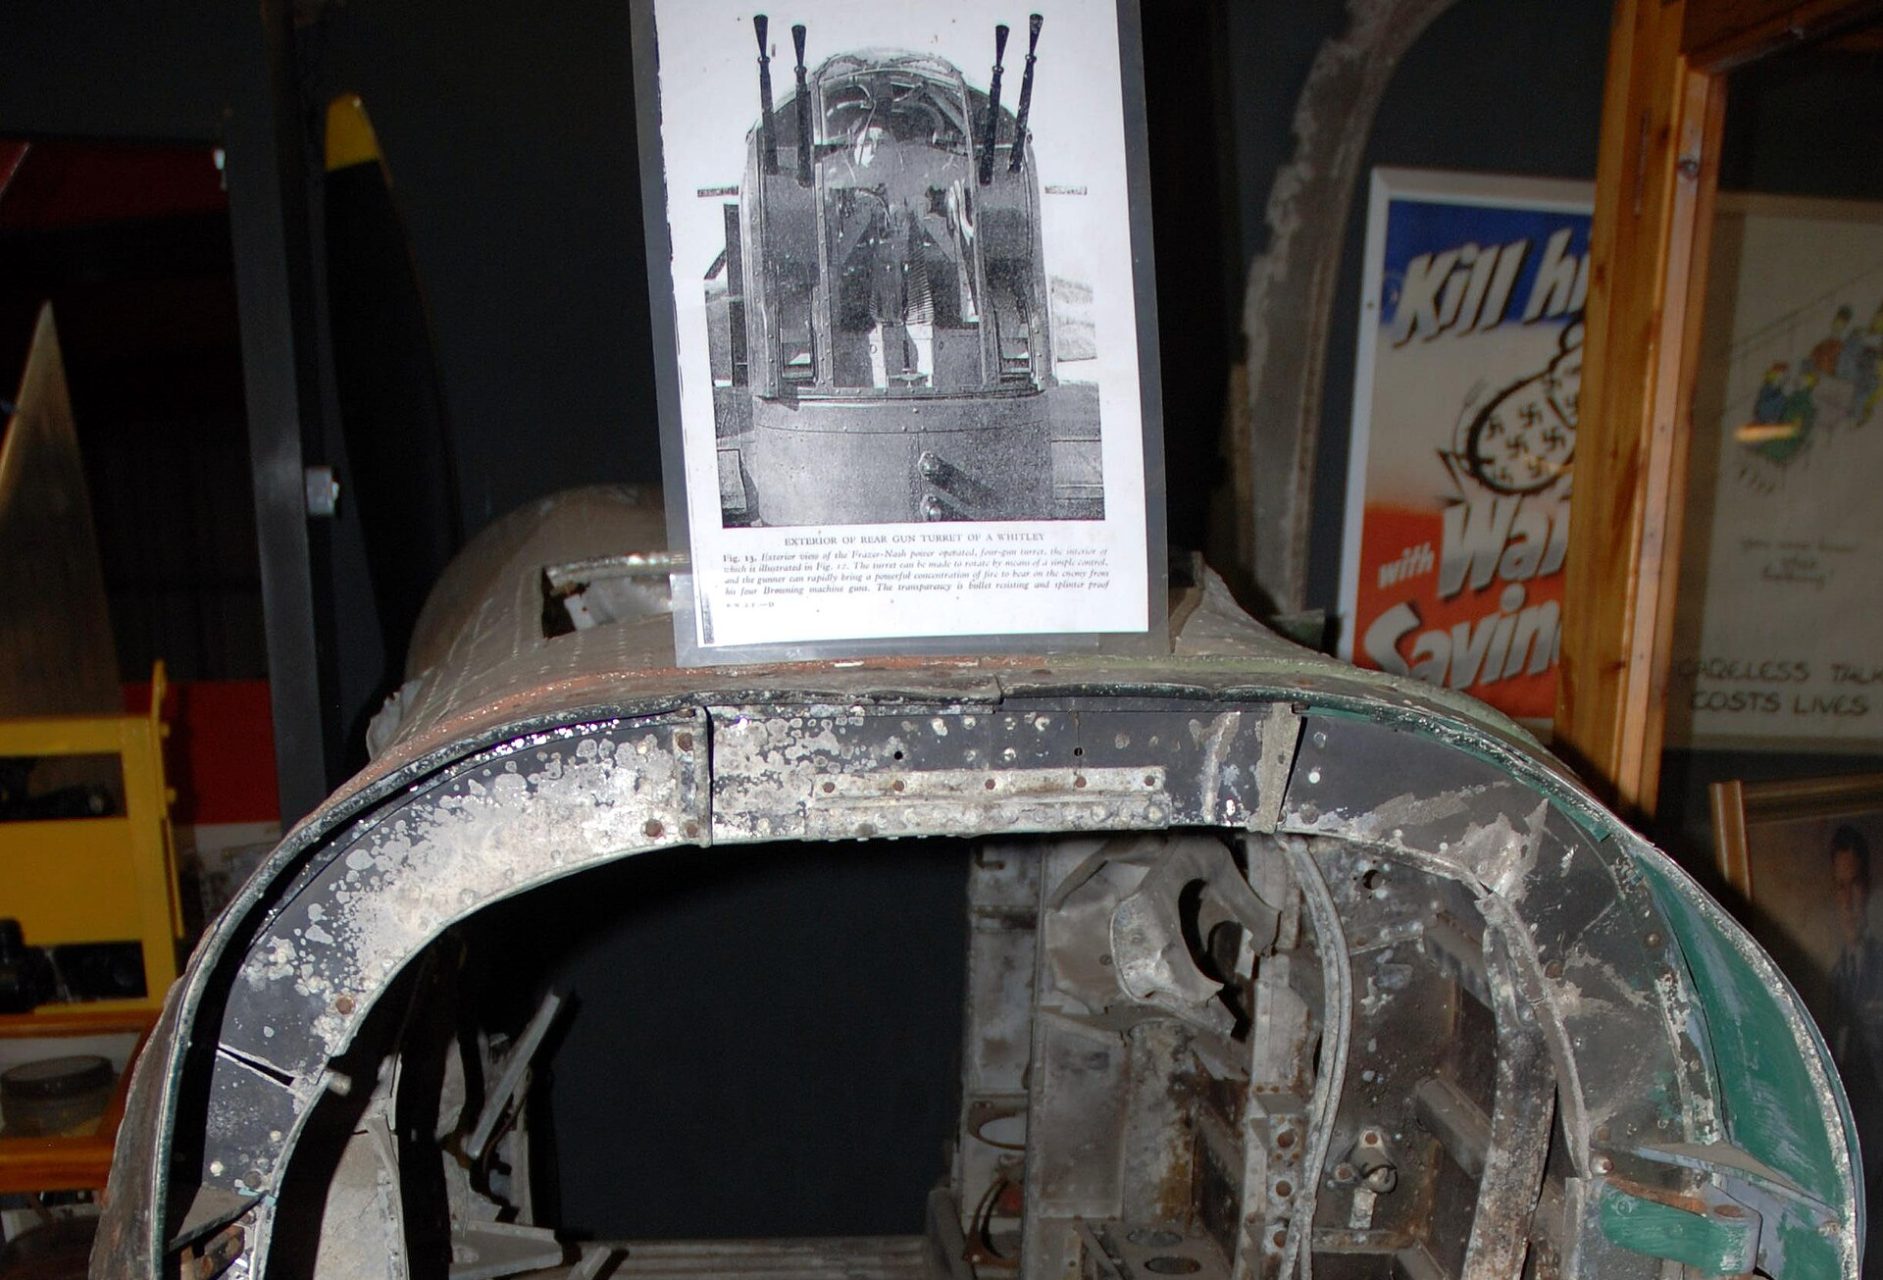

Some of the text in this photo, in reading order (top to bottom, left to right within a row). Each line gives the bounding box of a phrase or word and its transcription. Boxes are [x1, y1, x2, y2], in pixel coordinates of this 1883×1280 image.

[1392, 240, 1532, 348] Kill
[784, 533, 1045, 546] EXTERIOR OF REAR GUN TURRET OF A WHITLEY
[761, 552, 796, 562] Exterior
[799, 551, 819, 560] view
[822, 551, 832, 563] of
[834, 550, 848, 559] the
[852, 549, 907, 559] Frazer-Nash
[909, 550, 934, 559] power
[1050, 547, 1062, 556] the
[1099, 547, 1109, 556] of
[749, 564, 756, 573] is
[758, 563, 802, 573] illustrated
[804, 563, 813, 571] in
[854, 560, 870, 569] The
[872, 561, 897, 569] turret
[917, 560, 927, 568] be
[928, 560, 951, 568] made
[992, 559, 1002, 568] by
[1005, 559, 1031, 567] means
[1032, 558, 1042, 568] of
[1050, 558, 1075, 568] simple
[1378, 541, 1434, 590] with
[724, 575, 740, 585] and
[742, 575, 755, 584] the
[757, 576, 786, 586] gunner
[807, 573, 838, 583] rapidly
[841, 573, 863, 582] bring
[875, 571, 911, 582] powerful
[913, 571, 970, 580] concentration
[972, 570, 981, 581] of
[983, 570, 998, 580] fire
[1001, 570, 1010, 578] to
[1012, 569, 1030, 578] bear
[1046, 569, 1059, 578] the
[1061, 570, 1087, 579] enemy
[1089, 569, 1110, 579] from
[725, 586, 736, 596] his
[740, 586, 757, 597] four
[763, 586, 805, 595] Browning
[809, 585, 844, 593] machine
[876, 582, 893, 592] The
[897, 582, 952, 592] transparency
[956, 582, 963, 590] is
[968, 581, 992, 590] bullet
[995, 581, 1030, 591] resisting
[1034, 581, 1050, 589] and
[1055, 581, 1085, 590] splinter
[1088, 580, 1110, 590] proof
[1364, 583, 1561, 690] Savin
[1689, 690, 1870, 716] COSTS LIVES
